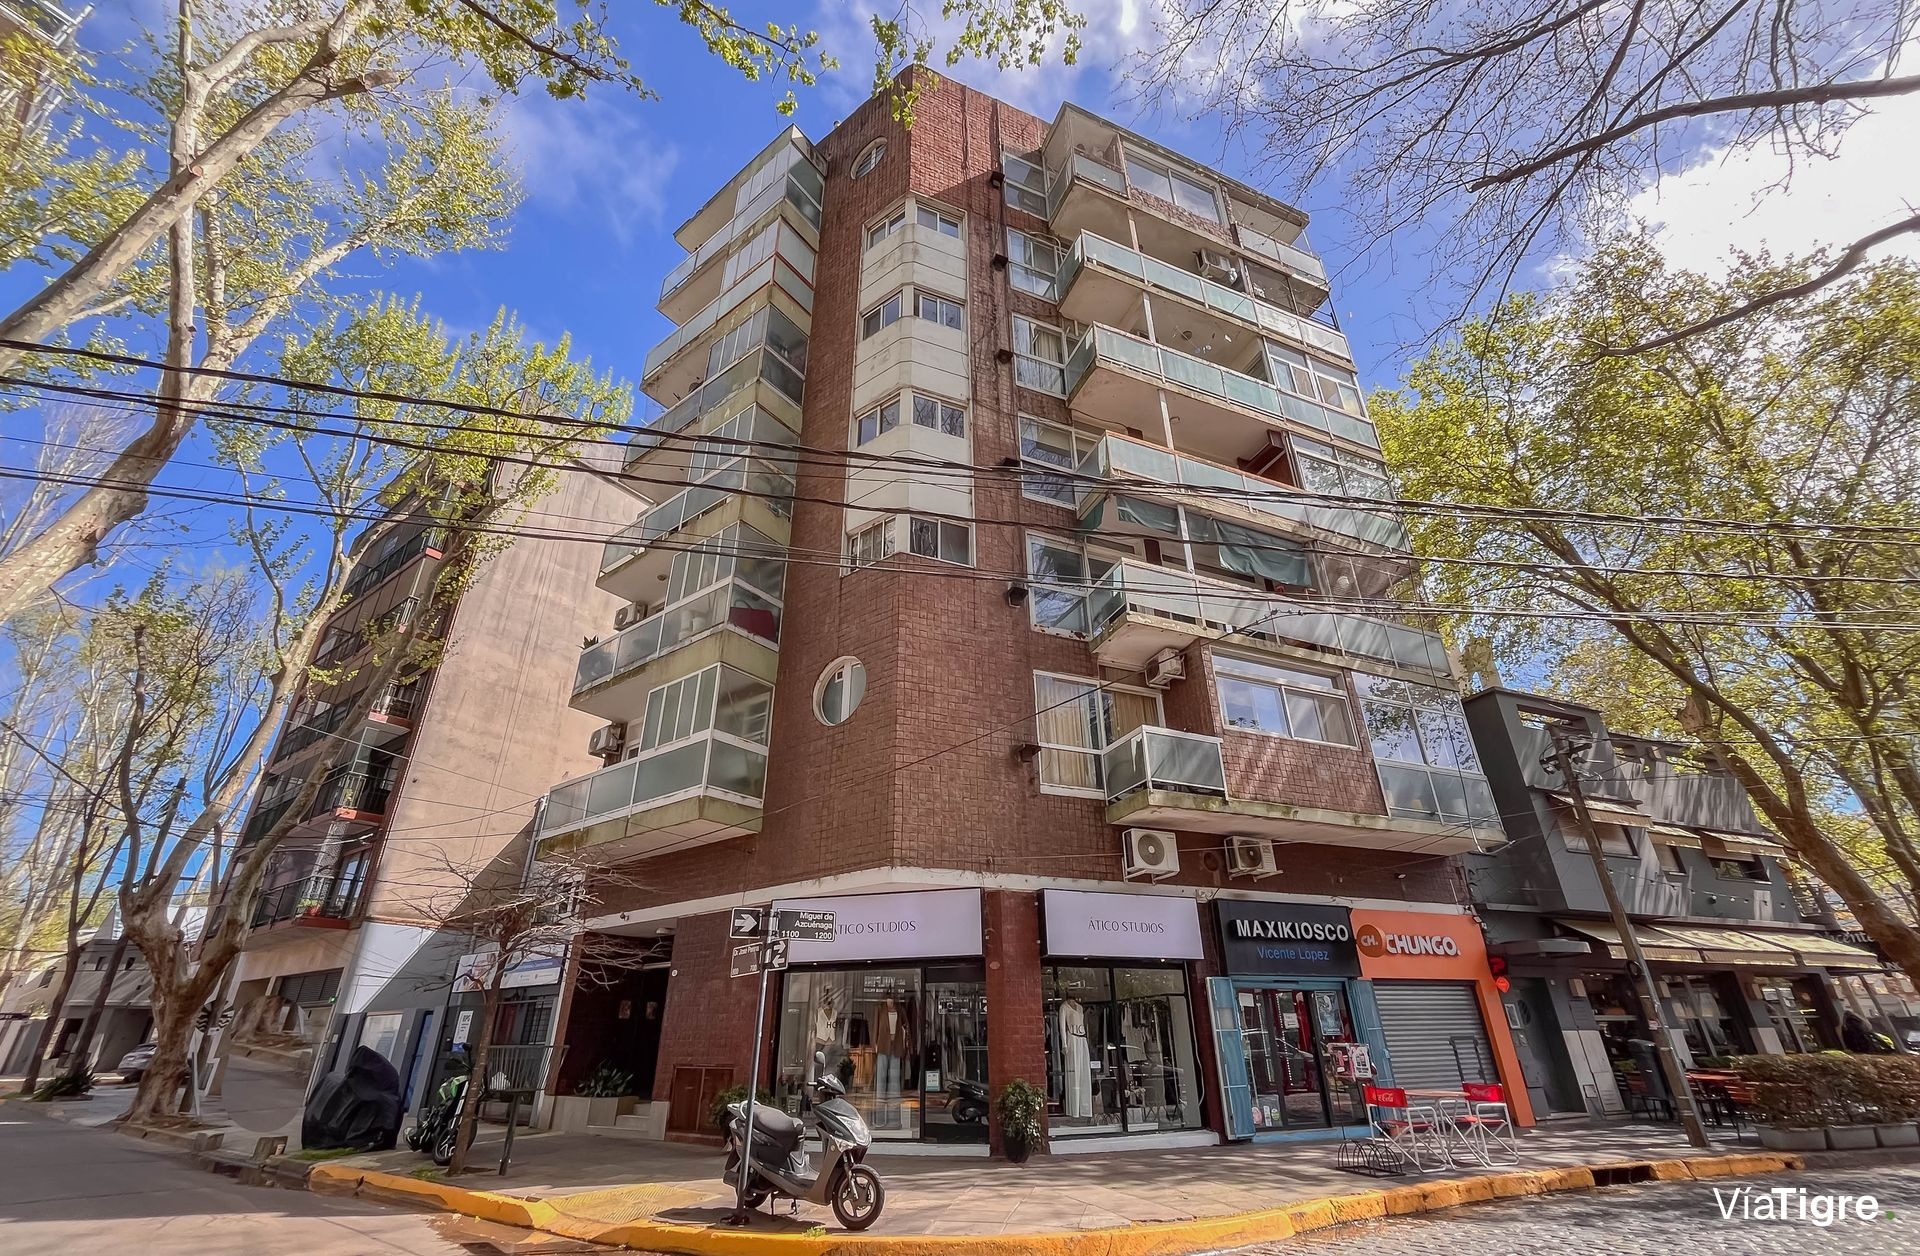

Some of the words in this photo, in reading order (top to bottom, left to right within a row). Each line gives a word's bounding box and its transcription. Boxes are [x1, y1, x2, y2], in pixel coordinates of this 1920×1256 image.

[800, 912, 823, 921] Miguel
[794, 920, 833, 931] Azcuénaga
[835, 923, 864, 935] TICO
[867, 920, 917, 934] STUDIOS
[1088, 916, 1120, 932] ÁTICO
[1121, 921, 1165, 934] STUDIOS
[1236, 919, 1349, 942] MAXIKIOSCO
[781, 930, 800, 939] 1100
[814, 932, 833, 940] 1200
[1257, 945, 1297, 960] Vicente
[1299, 945, 1330, 963] López
